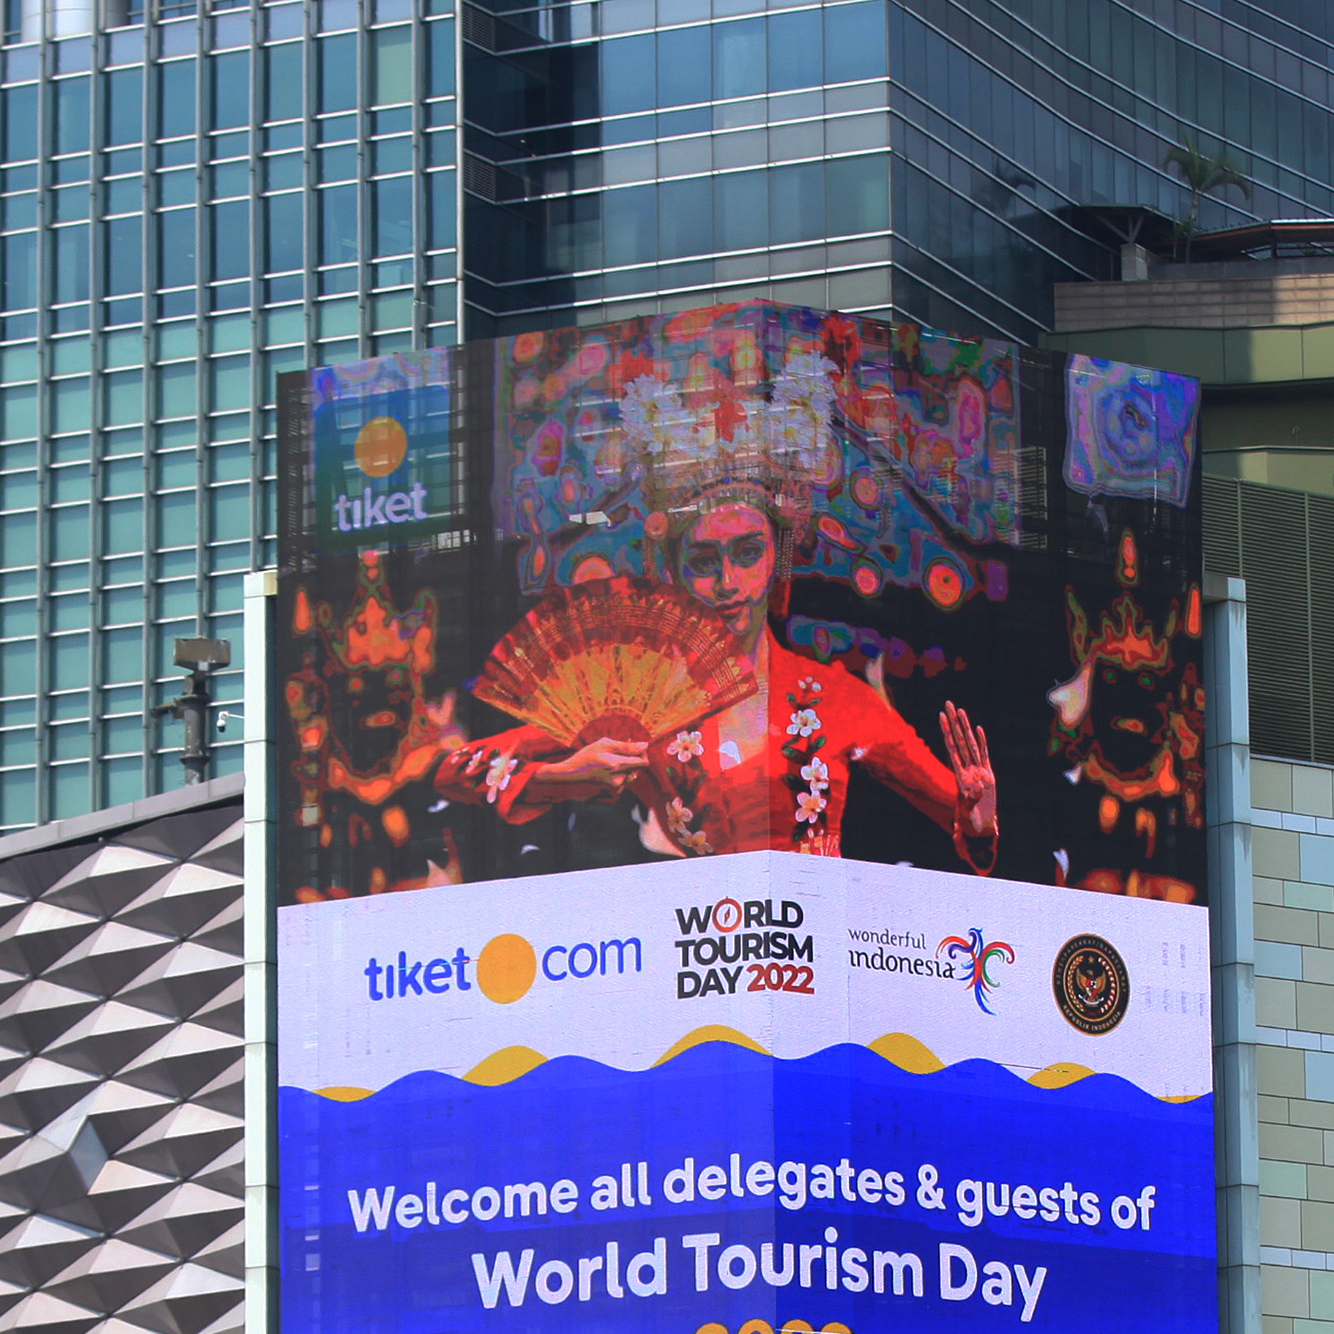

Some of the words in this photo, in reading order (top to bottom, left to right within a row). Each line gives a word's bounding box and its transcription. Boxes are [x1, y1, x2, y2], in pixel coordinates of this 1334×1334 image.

[334, 482, 427, 532] tiket
[675, 896, 804, 935] WORLD
[675, 932, 814, 967] TOURISM
[848, 927, 927, 950] wonderful
[677, 965, 744, 999] DAY
[747, 962, 815, 995] 2022
[848, 947, 957, 980] indonesia
[347, 1178, 578, 1233] Welcome
[589, 1161, 652, 1210] all
[663, 1153, 906, 1211] delegates
[916, 1163, 946, 1210] &
[956, 1178, 1102, 1227] guests
[1111, 1185, 1156, 1231] of
[471, 1237, 667, 1309] World
[682, 1226, 924, 1298] Tourism
[938, 1242, 1048, 1322] Day
